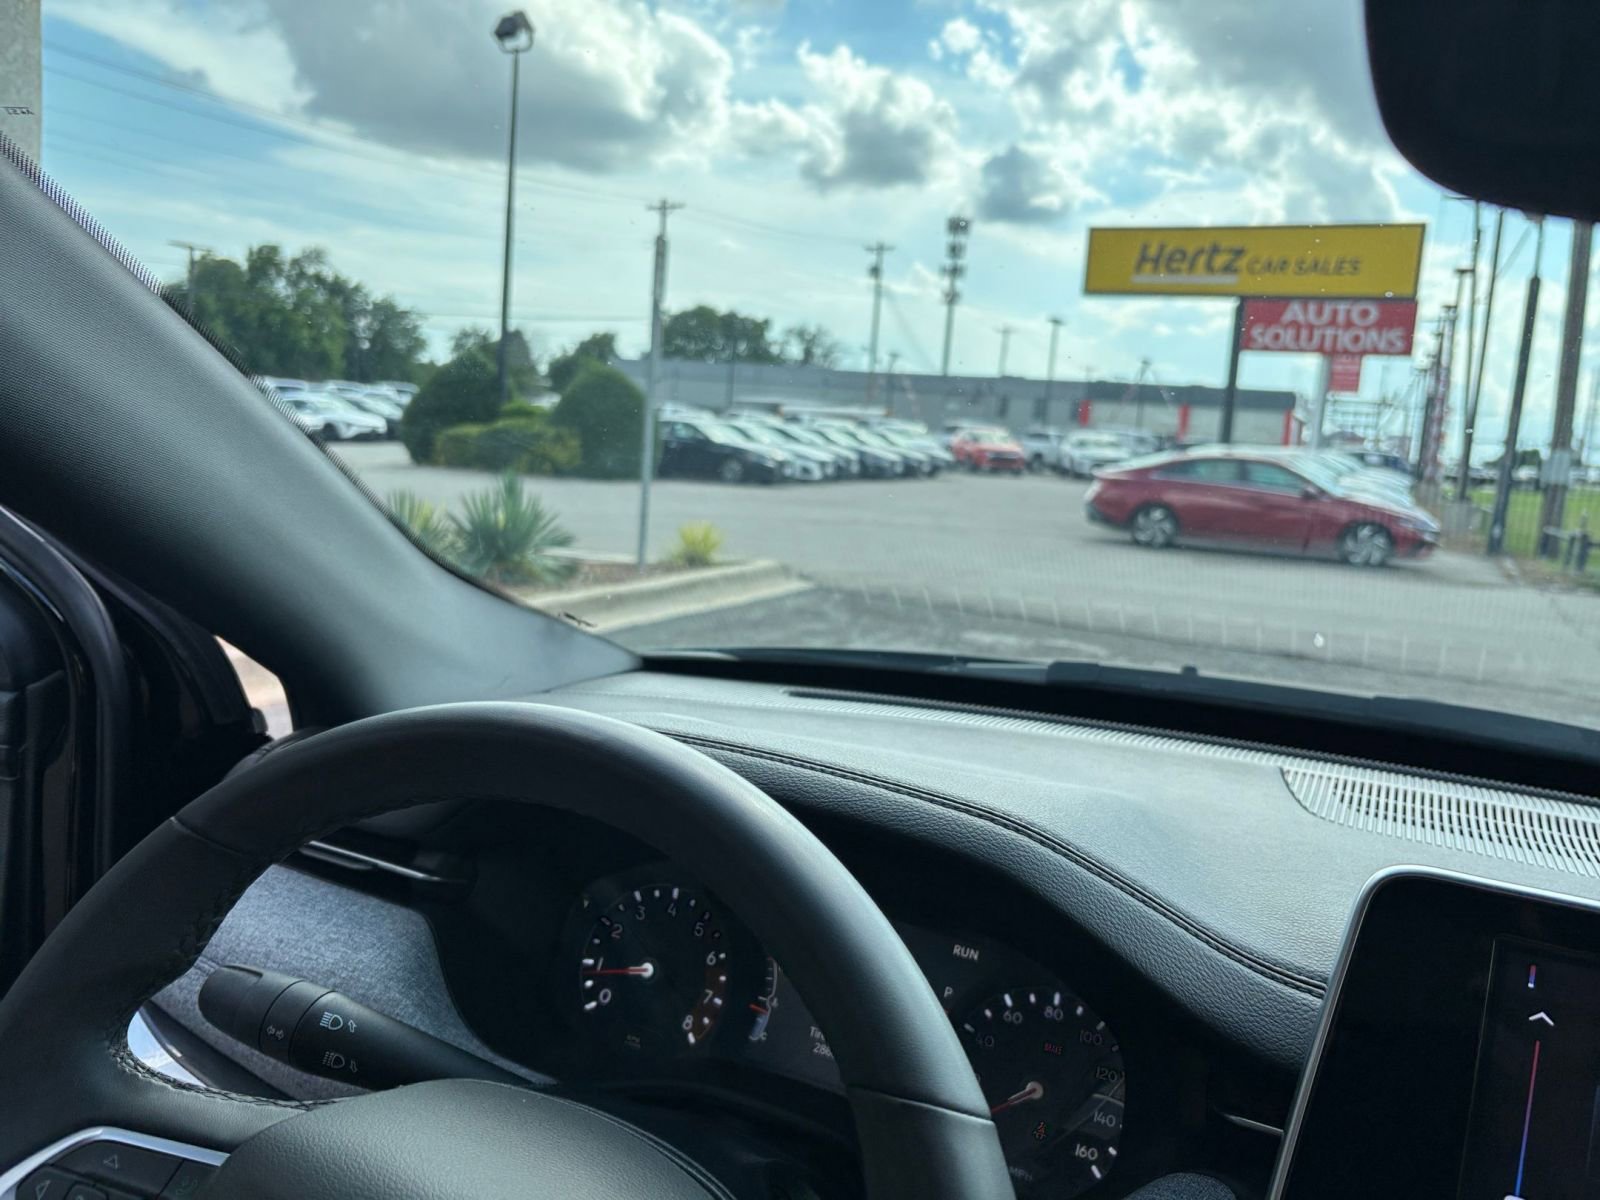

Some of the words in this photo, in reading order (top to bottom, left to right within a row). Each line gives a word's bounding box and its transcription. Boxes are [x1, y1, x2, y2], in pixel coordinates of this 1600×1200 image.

[1135, 241, 1245, 275] Hertz
[1246, 259, 1288, 276] CAR
[1293, 256, 1362, 276] SALES
[1280, 301, 1379, 326] AUTO
[1250, 326, 1407, 351] SOLUTIONS
[635, 904, 646, 920] 3
[667, 903, 677, 918] 4
[611, 924, 623, 939] 2
[694, 922, 704, 937] 5
[706, 951, 716, 966] 6
[953, 944, 980, 961] RUN
[600, 988, 612, 1004] 0
[703, 989, 713, 1004] 7
[944, 986, 953, 998] P
[1003, 1009, 1023, 1025] 60
[1044, 1005, 1063, 1022] 80
[682, 1014, 694, 1031] 8
[1079, 1030, 1102, 1046] 100
[1095, 1066, 1118, 1083] 120
[1093, 1112, 1116, 1128] 140
[1075, 1143, 1099, 1161] 160
